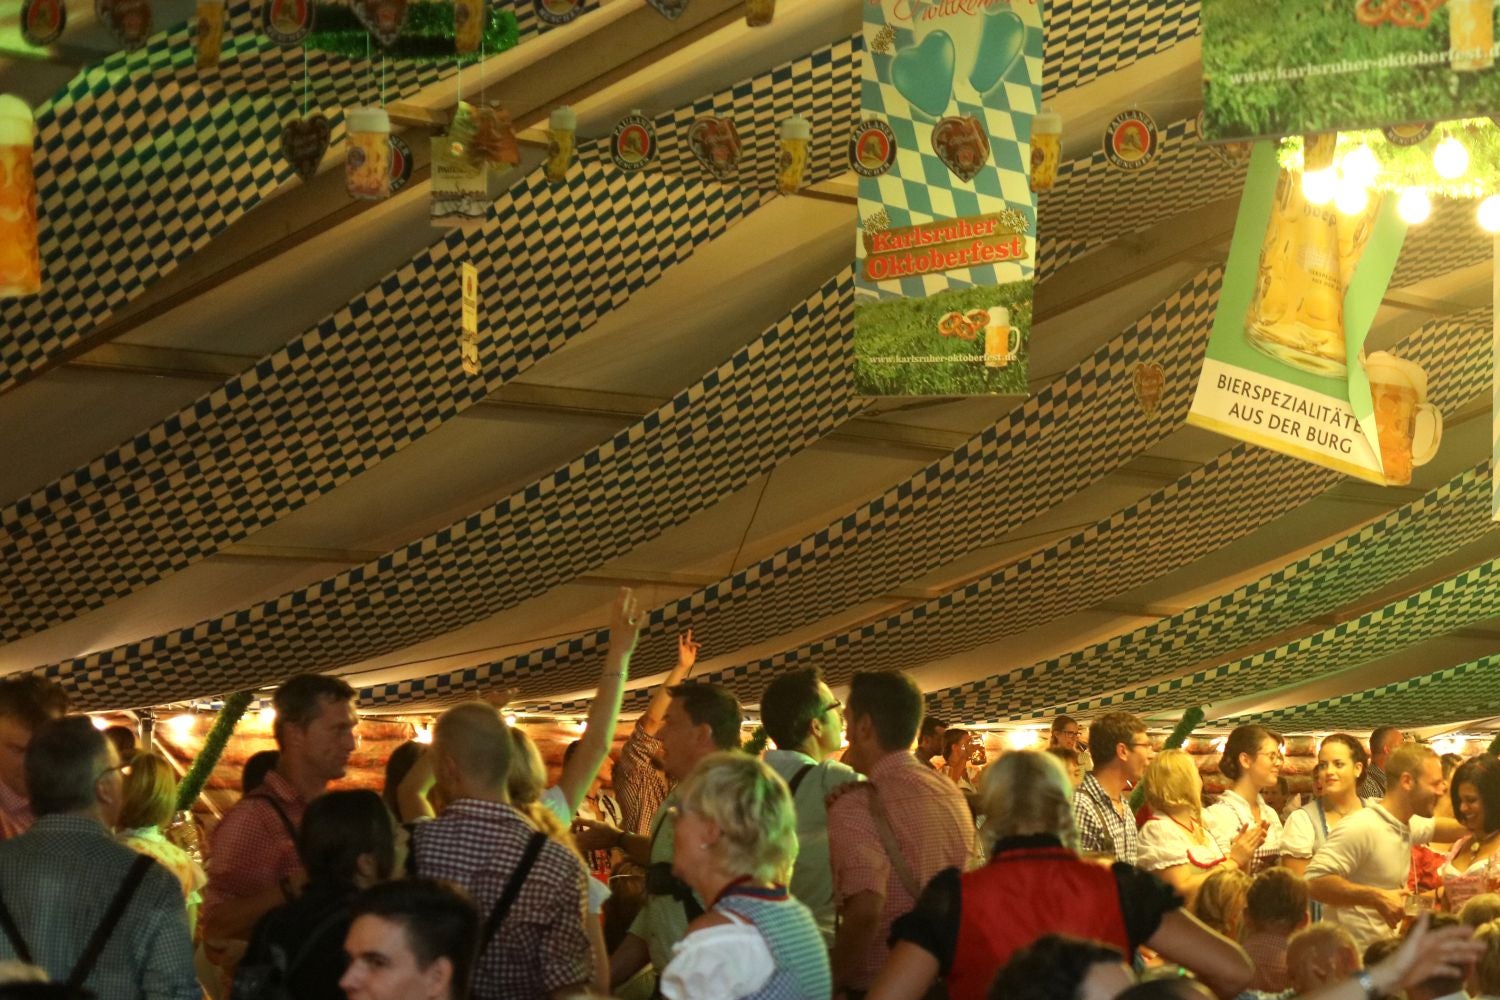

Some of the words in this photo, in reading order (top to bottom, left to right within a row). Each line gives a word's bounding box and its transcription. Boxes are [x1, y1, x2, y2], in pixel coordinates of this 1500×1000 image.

[872, 218, 999, 253] Karlsruher
[868, 237, 1022, 279] Oktoberfest
[869, 353, 1017, 364] www.karlsruher-oktoberfest.de
[1217, 374, 1365, 434] BIERSPEZIALITÄTE
[1228, 402, 1264, 425] AUS
[1268, 414, 1301, 438] DER
[1306, 426, 1353, 455] BURG
